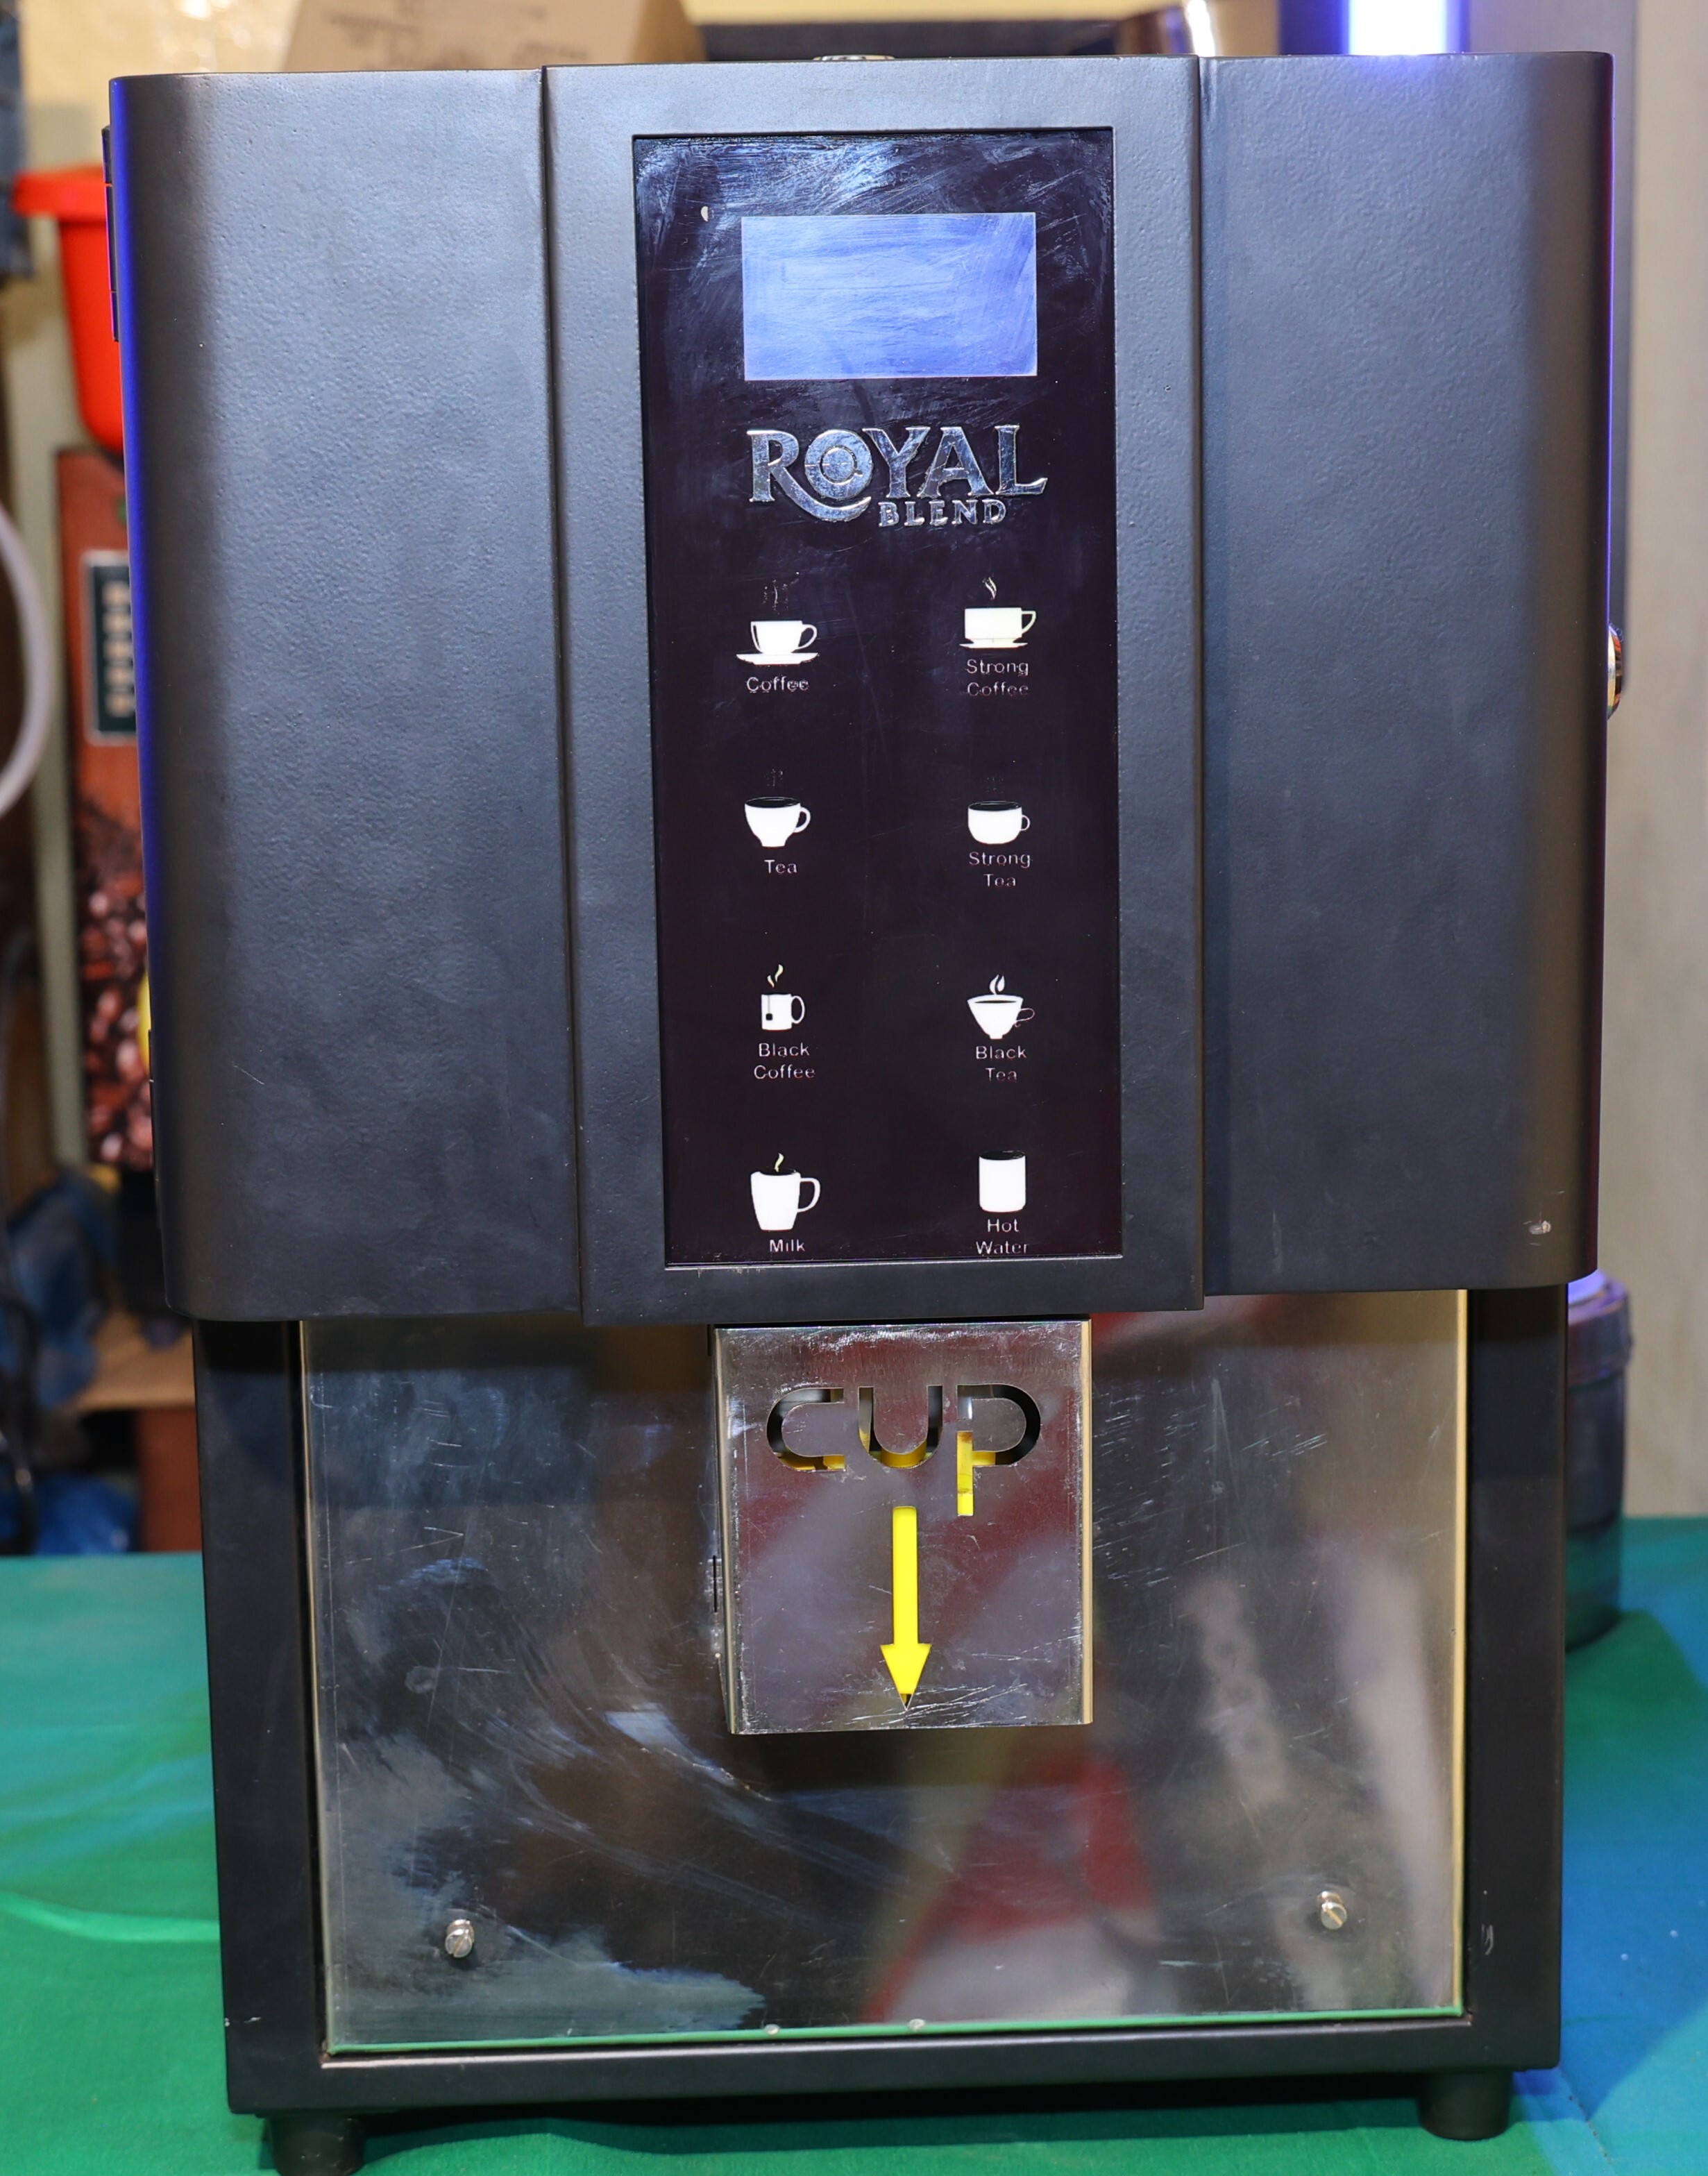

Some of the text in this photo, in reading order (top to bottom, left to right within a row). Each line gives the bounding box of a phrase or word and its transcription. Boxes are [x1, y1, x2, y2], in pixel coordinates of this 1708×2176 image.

[746, 425, 1048, 523] ROYAL
[879, 499, 1006, 528] BLEND
[965, 658, 1029, 676] Strong
[746, 675, 809, 693] Coffee
[967, 681, 1029, 696] Coffee
[764, 859, 797, 874] Tea
[969, 851, 1031, 869] Strong
[983, 873, 1016, 887] Tea
[759, 1042, 810, 1058] Black
[976, 1045, 1026, 1060] Black
[754, 1063, 815, 1079] Coffee
[985, 1067, 1017, 1081] Tea
[987, 1218, 1020, 1233] Hot
[769, 1239, 806, 1253] Milk
[975, 1240, 1028, 1255] Water
[767, 1384, 1040, 1515] CUP
